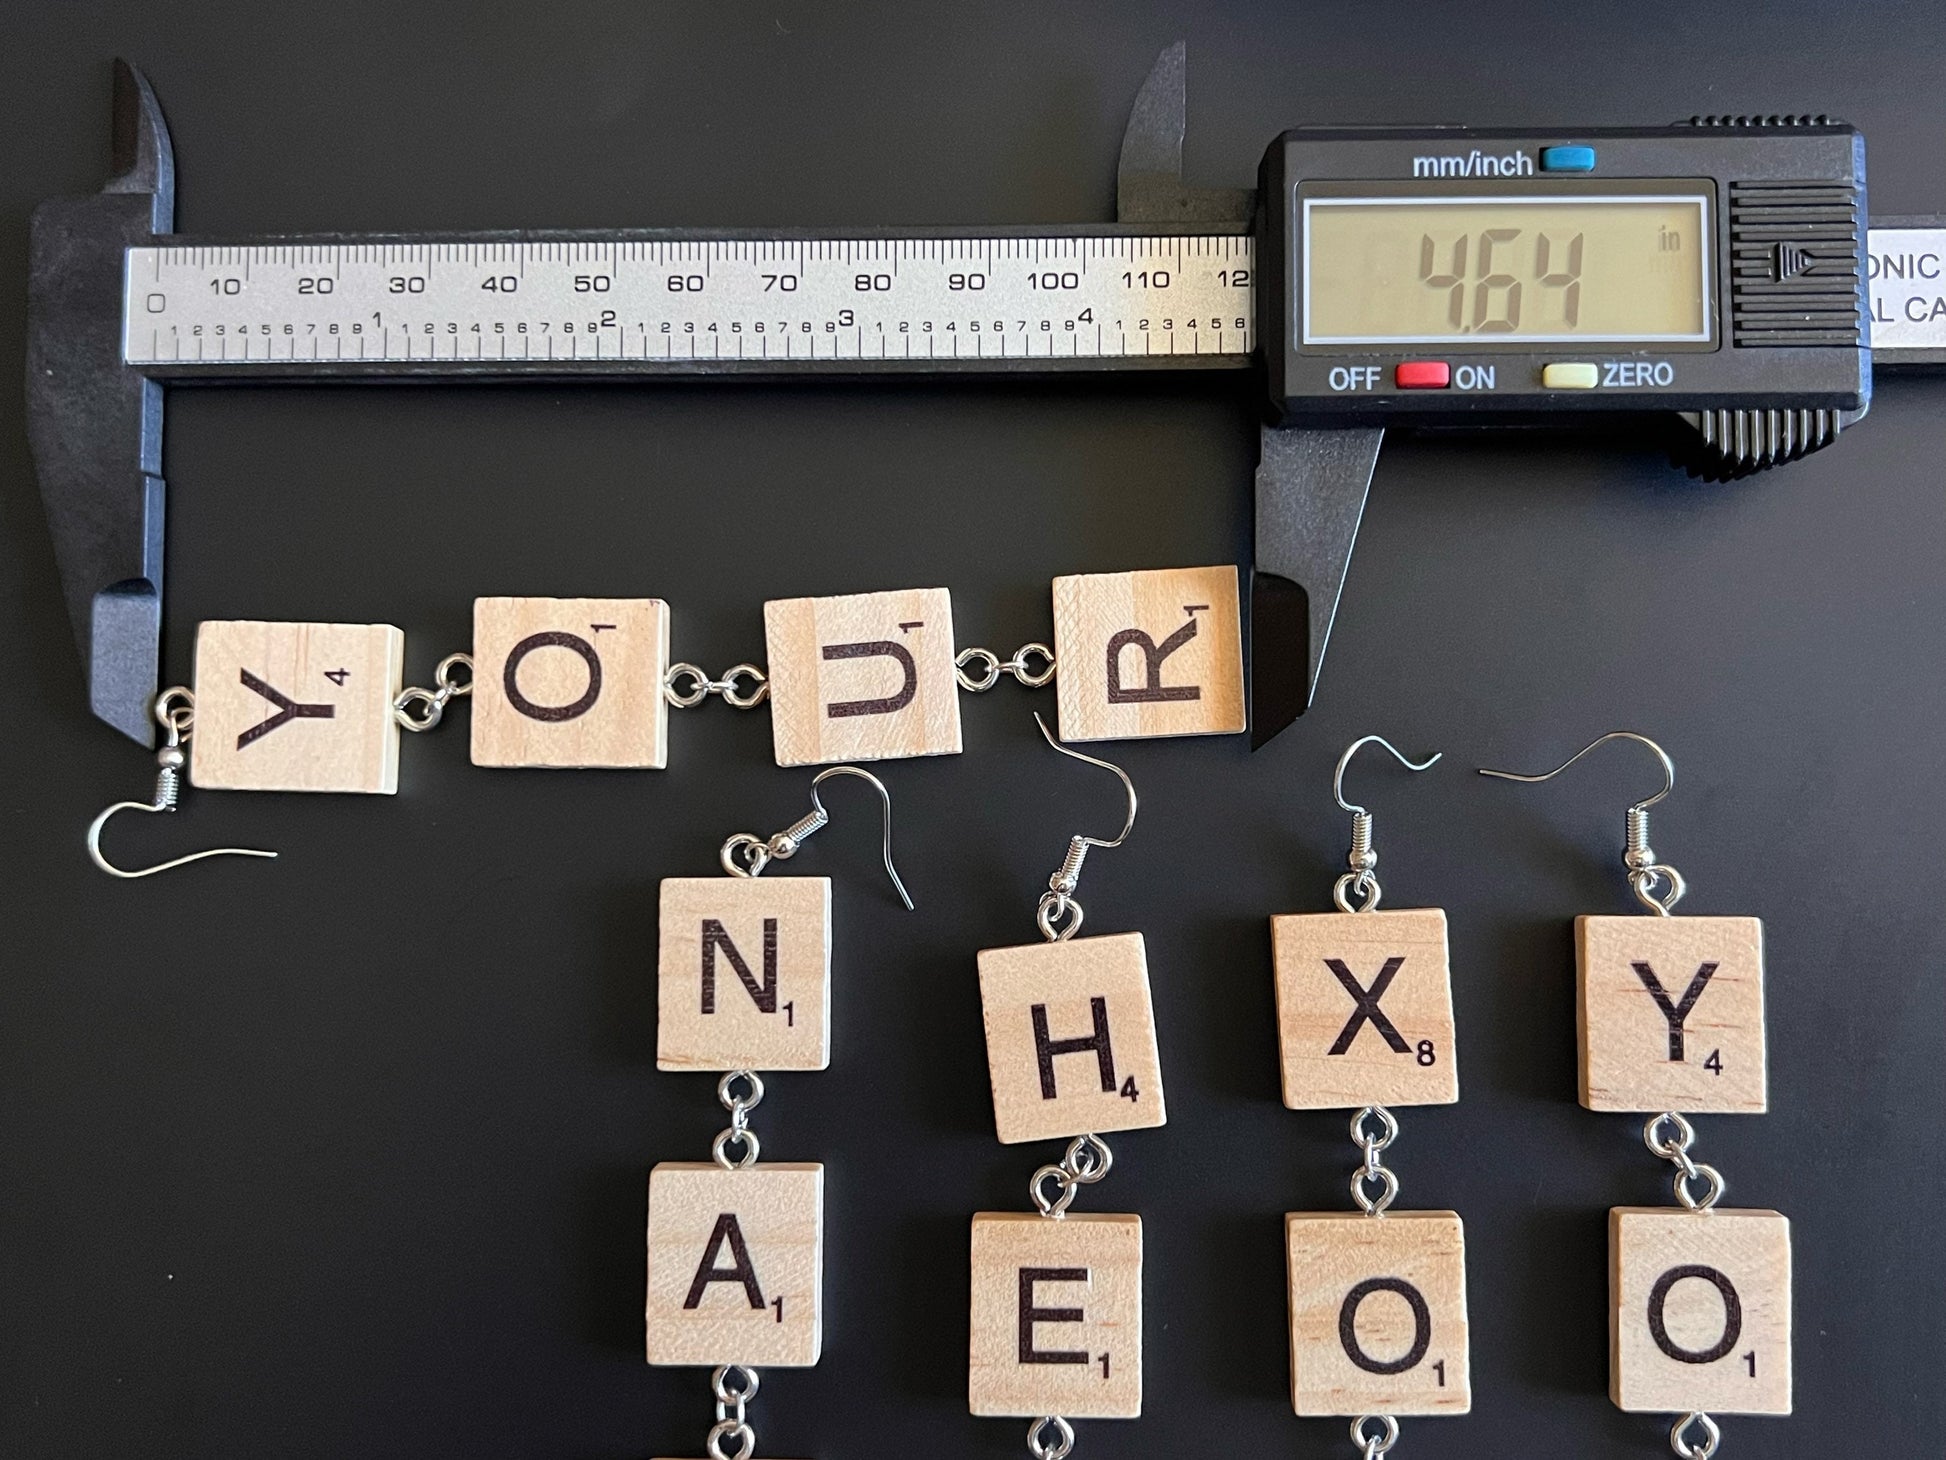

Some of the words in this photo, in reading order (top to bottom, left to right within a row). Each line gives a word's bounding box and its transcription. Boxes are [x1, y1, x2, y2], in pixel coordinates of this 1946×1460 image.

[1413, 152, 1533, 178] mm/inch
[1660, 224, 1681, 251] in
[147, 294, 165, 313] 0
[211, 279, 240, 294] 10
[299, 278, 333, 294] 20
[390, 277, 424, 293] 30
[482, 276, 517, 292] 40
[575, 276, 610, 292] 50
[668, 276, 703, 292] 60
[762, 275, 797, 291] 70
[855, 275, 890, 291] 80
[949, 274, 985, 290] 90
[1028, 273, 1078, 289] 100
[1123, 272, 1169, 288] 110
[172, 326, 176, 334] 1
[194, 326, 202, 335] 2
[216, 325, 224, 335] 3
[239, 326, 247, 334] 4
[262, 325, 271, 335] 5
[284, 324, 293, 334] 6
[307, 324, 315, 333] 7
[330, 324, 338, 334] 8
[353, 324, 361, 334] 9
[373, 312, 380, 327] 1
[403, 324, 407, 333] 1
[425, 323, 434, 333] 2
[448, 323, 457, 333] 3
[471, 324, 480, 332] 4
[495, 323, 504, 333] 5
[518, 323, 526, 333] 6
[541, 323, 549, 332] 7
[564, 323, 573, 333] 8
[588, 323, 597, 333] 9
[601, 311, 615, 326] 2
[639, 323, 643, 332] 1
[661, 322, 670, 333] 2
[685, 323, 693, 333] 3
[708, 323, 717, 332] 4
[732, 323, 741, 332] 5
[755, 322, 764, 332] 6
[779, 322, 787, 332] 7
[802, 322, 811, 332] 8
[826, 322, 835, 332] 9
[839, 310, 853, 326] 3
[877, 322, 881, 332] 1
[900, 322, 908, 332] 2
[923, 322, 932, 332] 3
[947, 322, 955, 331] 4
[971, 321, 980, 331] 5
[994, 321, 1003, 331] 6
[1018, 321, 1026, 331] 7
[1041, 321, 1050, 331] 8
[1065, 320, 1074, 330] 9
[1078, 308, 1093, 324] 4
[1116, 320, 1121, 329] 1
[1140, 319, 1149, 330] 2
[1163, 319, 1172, 329] 3
[1187, 319, 1196, 328] 4
[1212, 318, 1221, 329] 5
[1235, 318, 1245, 328] 6
[1328, 366, 1382, 391] OFF
[1455, 365, 1496, 390] ON
[1602, 363, 1674, 387] ZERO
[503, 628, 604, 722] O
[591, 624, 616, 633] 1
[822, 641, 917, 718] U
[899, 622, 923, 633] 1
[1107, 626, 1200, 704] R
[1184, 605, 1209, 616] 1
[237, 668, 338, 750] Y
[324, 668, 349, 686] 4
[701, 919, 777, 1014] N
[783, 1001, 793, 1026] 1
[1323, 957, 1412, 1055] X
[1417, 1040, 1435, 1066] 8
[1631, 962, 1719, 1064] Y
[1704, 1049, 1723, 1075] 4
[1031, 997, 1116, 1100] H
[1121, 1076, 1139, 1102] 4
[683, 1214, 766, 1309] A
[771, 1296, 782, 1323] 1
[1019, 1267, 1089, 1364] E
[1098, 1353, 1109, 1379] 1
[1339, 1278, 1431, 1375] O
[1433, 1360, 1444, 1386] 1
[1648, 1265, 1741, 1364] O
[1744, 1351, 1755, 1377] 1
